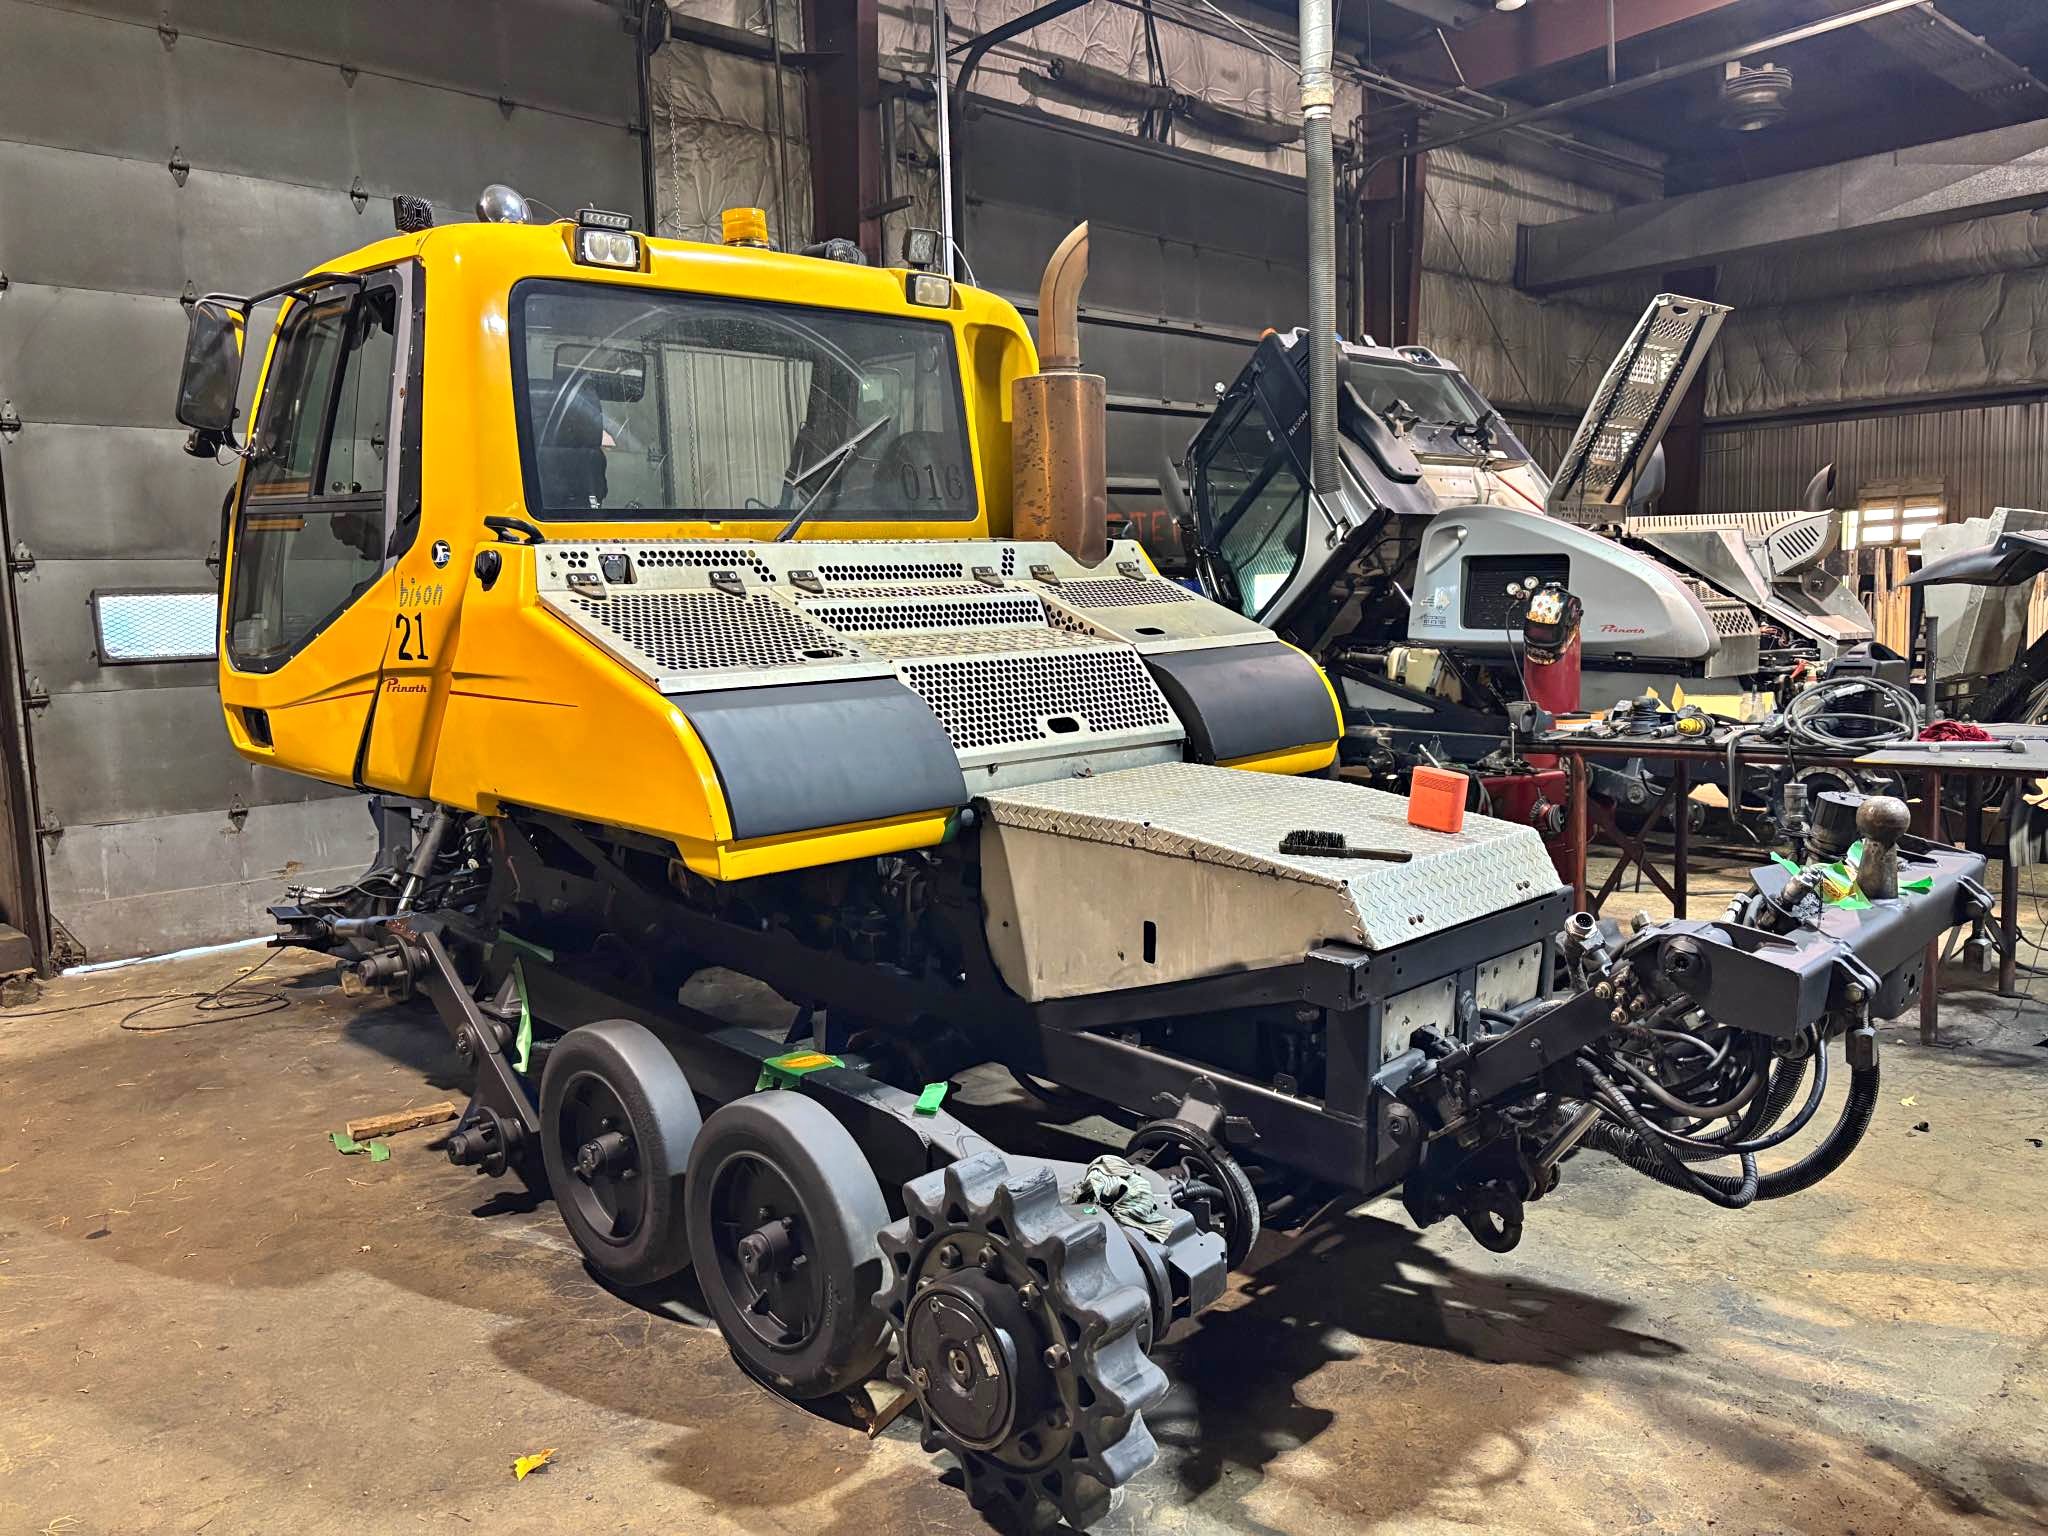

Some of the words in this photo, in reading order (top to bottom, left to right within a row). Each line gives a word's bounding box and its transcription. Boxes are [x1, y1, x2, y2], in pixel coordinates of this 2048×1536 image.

[399, 576, 444, 607] bison
[396, 612, 429, 661] 21
[1600, 624, 1646, 634] Prinoth
[383, 677, 428, 693] Prinoth
